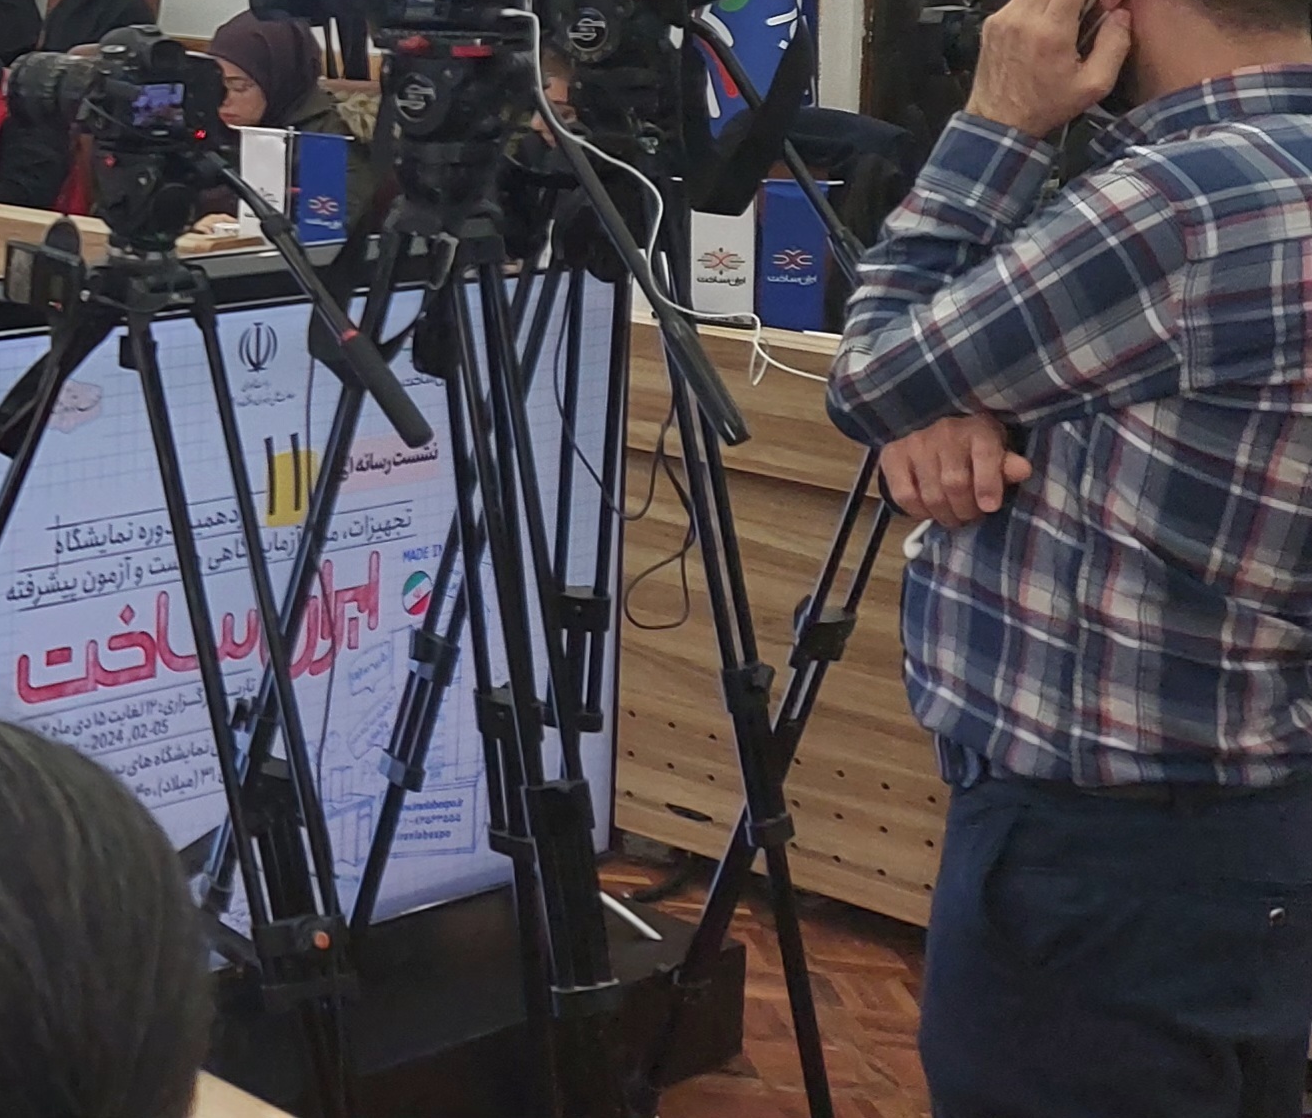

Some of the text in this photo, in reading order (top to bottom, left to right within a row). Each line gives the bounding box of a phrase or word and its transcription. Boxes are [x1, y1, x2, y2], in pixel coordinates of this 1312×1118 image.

[55, 521, 133, 554] نمایشگاه
[6, 572, 77, 604] پیشرفته
[82, 555, 132, 593] آزمون
